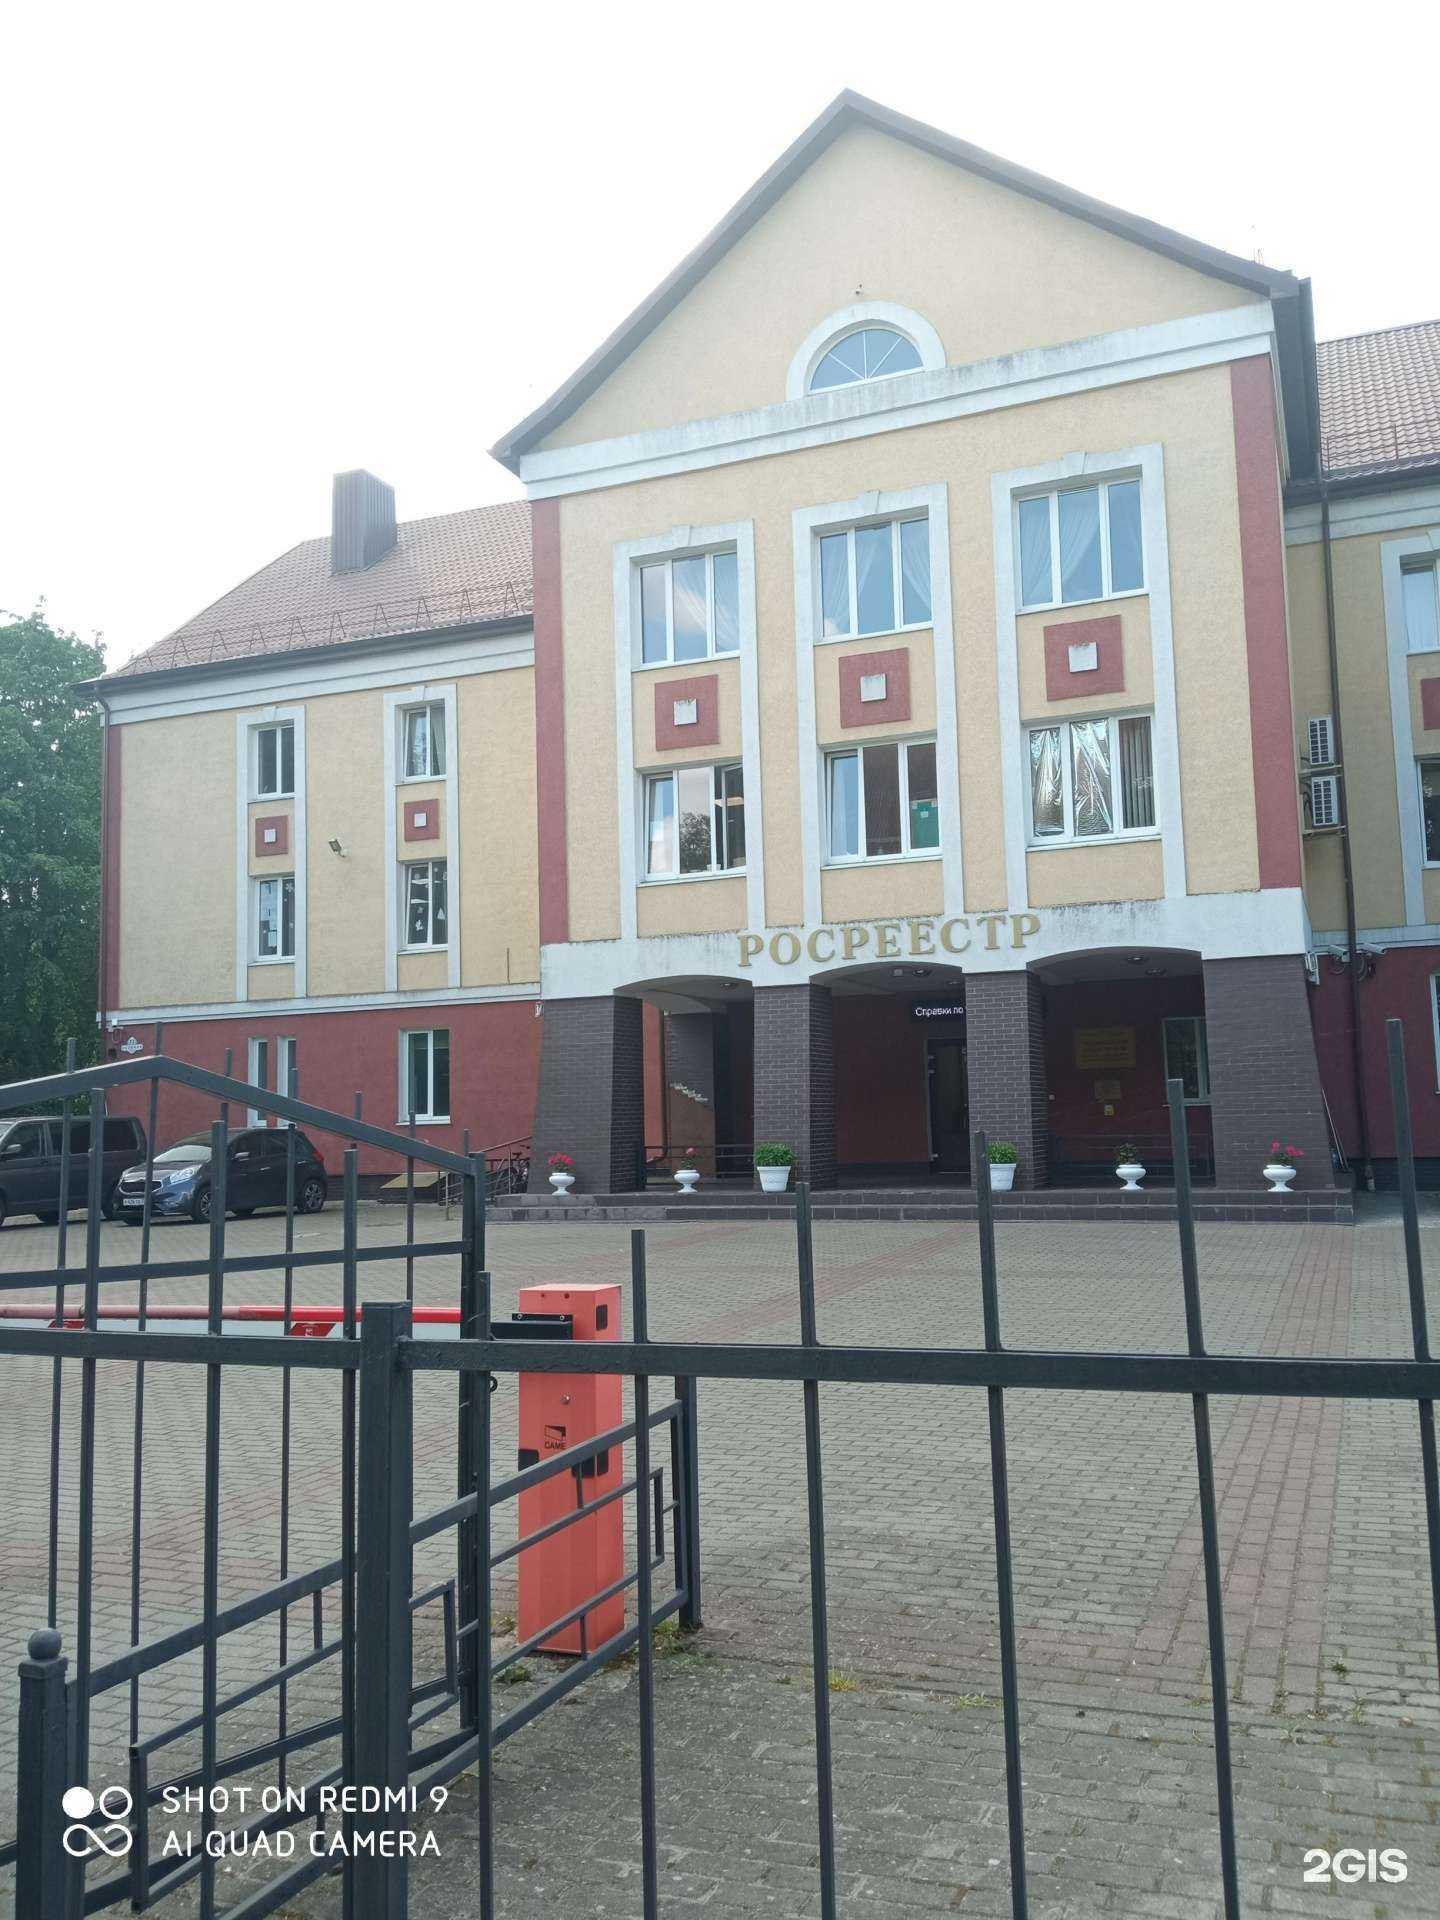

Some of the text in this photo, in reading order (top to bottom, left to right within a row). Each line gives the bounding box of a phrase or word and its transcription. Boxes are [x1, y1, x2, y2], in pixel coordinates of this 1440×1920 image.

[737, 913, 1041, 967] РОСРЕЕСТР
[915, 1006, 964, 1018] Справки по
[544, 1441, 567, 1450] CAME
